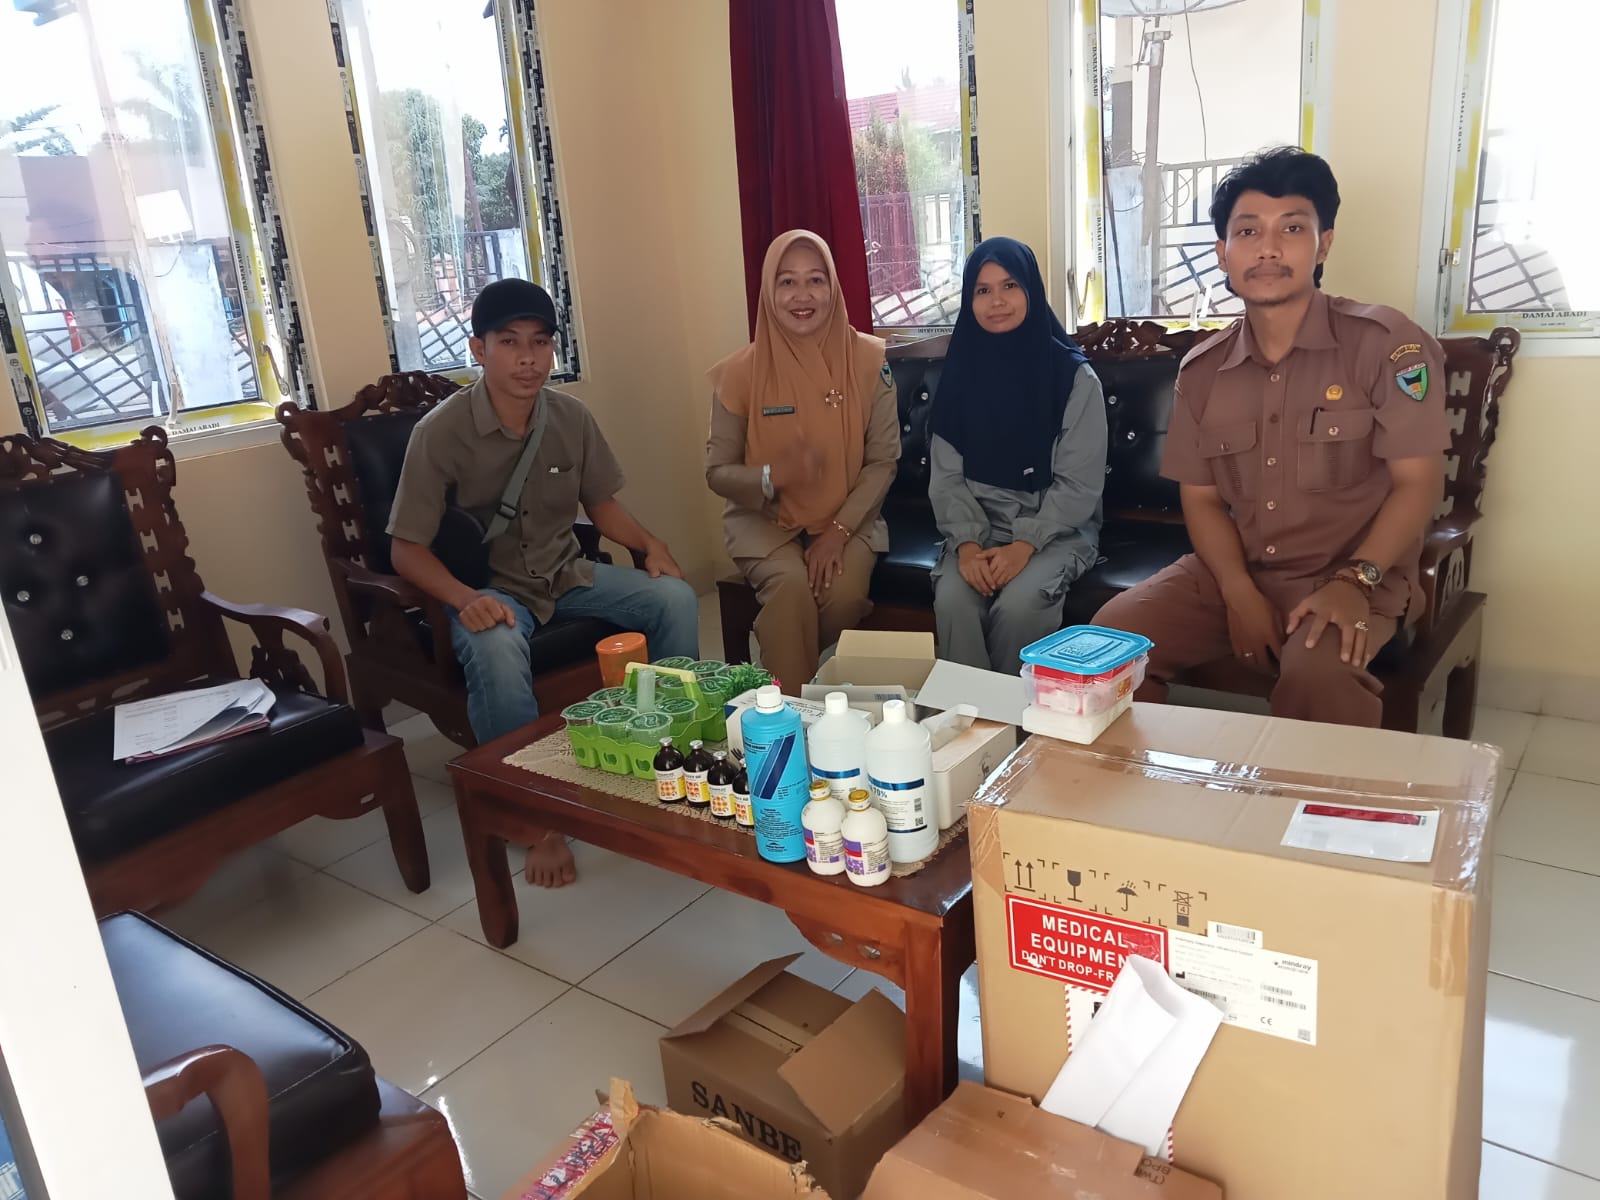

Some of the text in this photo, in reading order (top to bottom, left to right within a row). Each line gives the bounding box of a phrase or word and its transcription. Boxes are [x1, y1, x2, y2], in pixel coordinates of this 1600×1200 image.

[199, 51, 209, 78] ABADI
[204, 79, 215, 108] DAMAI
[234, 240, 243, 264] ABADI
[239, 265, 249, 291] DAMAI
[1522, 311, 1554, 319] DAMAI
[172, 422, 220, 436] DAMAI ABADI
[1042, 914, 1129, 948] MEDICAL
[1031, 933, 1129, 969] EQUIPMEN
[1021, 950, 1116, 983] DON'T DROP-FR
[1281, 959, 1312, 971] mindray
[691, 1080, 802, 1162] SANBE
